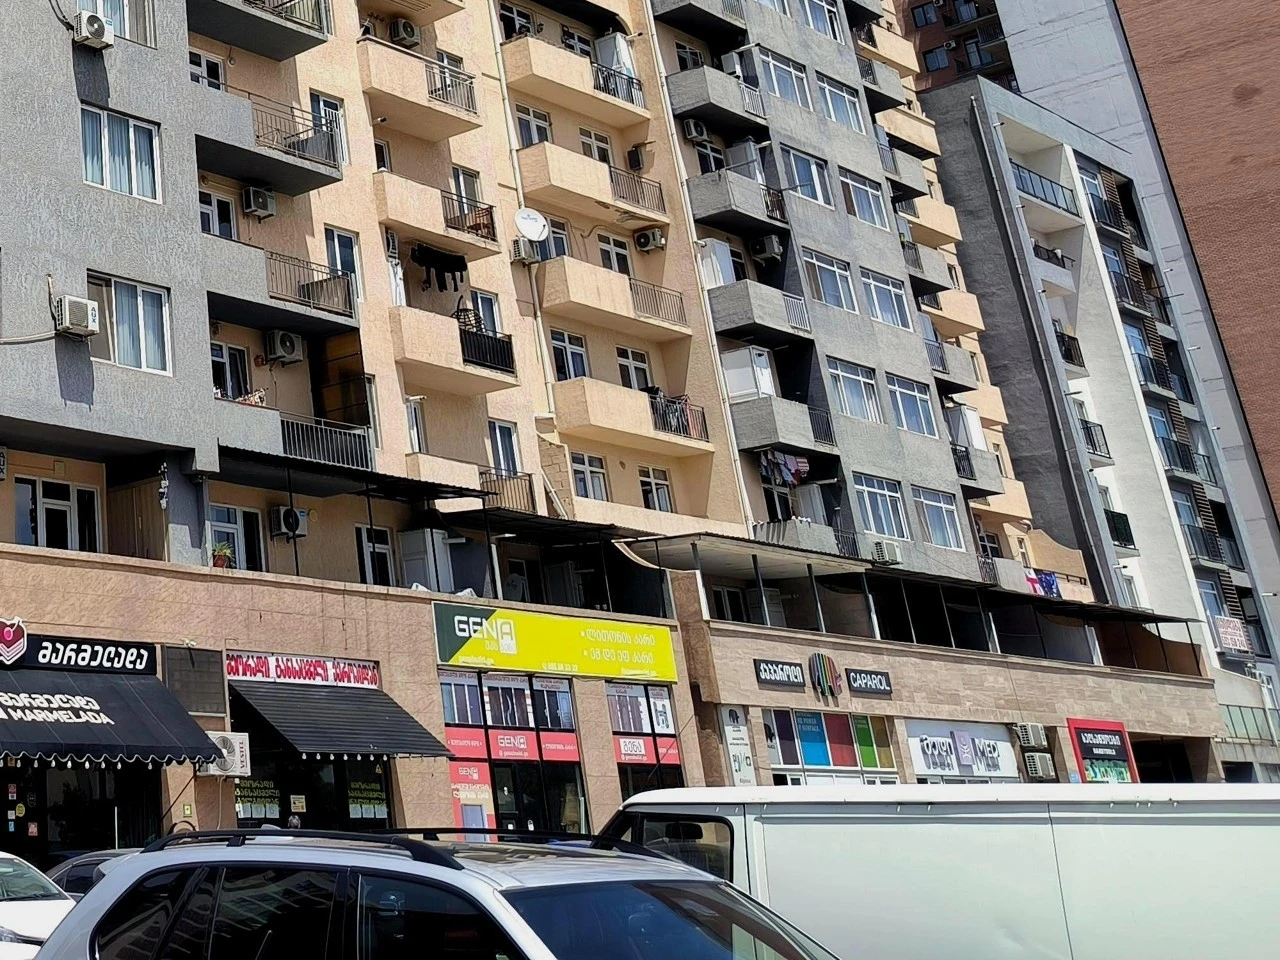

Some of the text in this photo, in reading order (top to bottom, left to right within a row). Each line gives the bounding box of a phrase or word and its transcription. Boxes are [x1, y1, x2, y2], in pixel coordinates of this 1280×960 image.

[453, 615, 514, 641] GENA
[37, 641, 149, 670] მარმელადა
[226, 653, 270, 678] მეორადი
[759, 662, 804, 683] კაპაროლი
[849, 672, 891, 691] CAPAROL
[7, 708, 115, 726] MARMELADA
[497, 735, 527, 748] GENA
